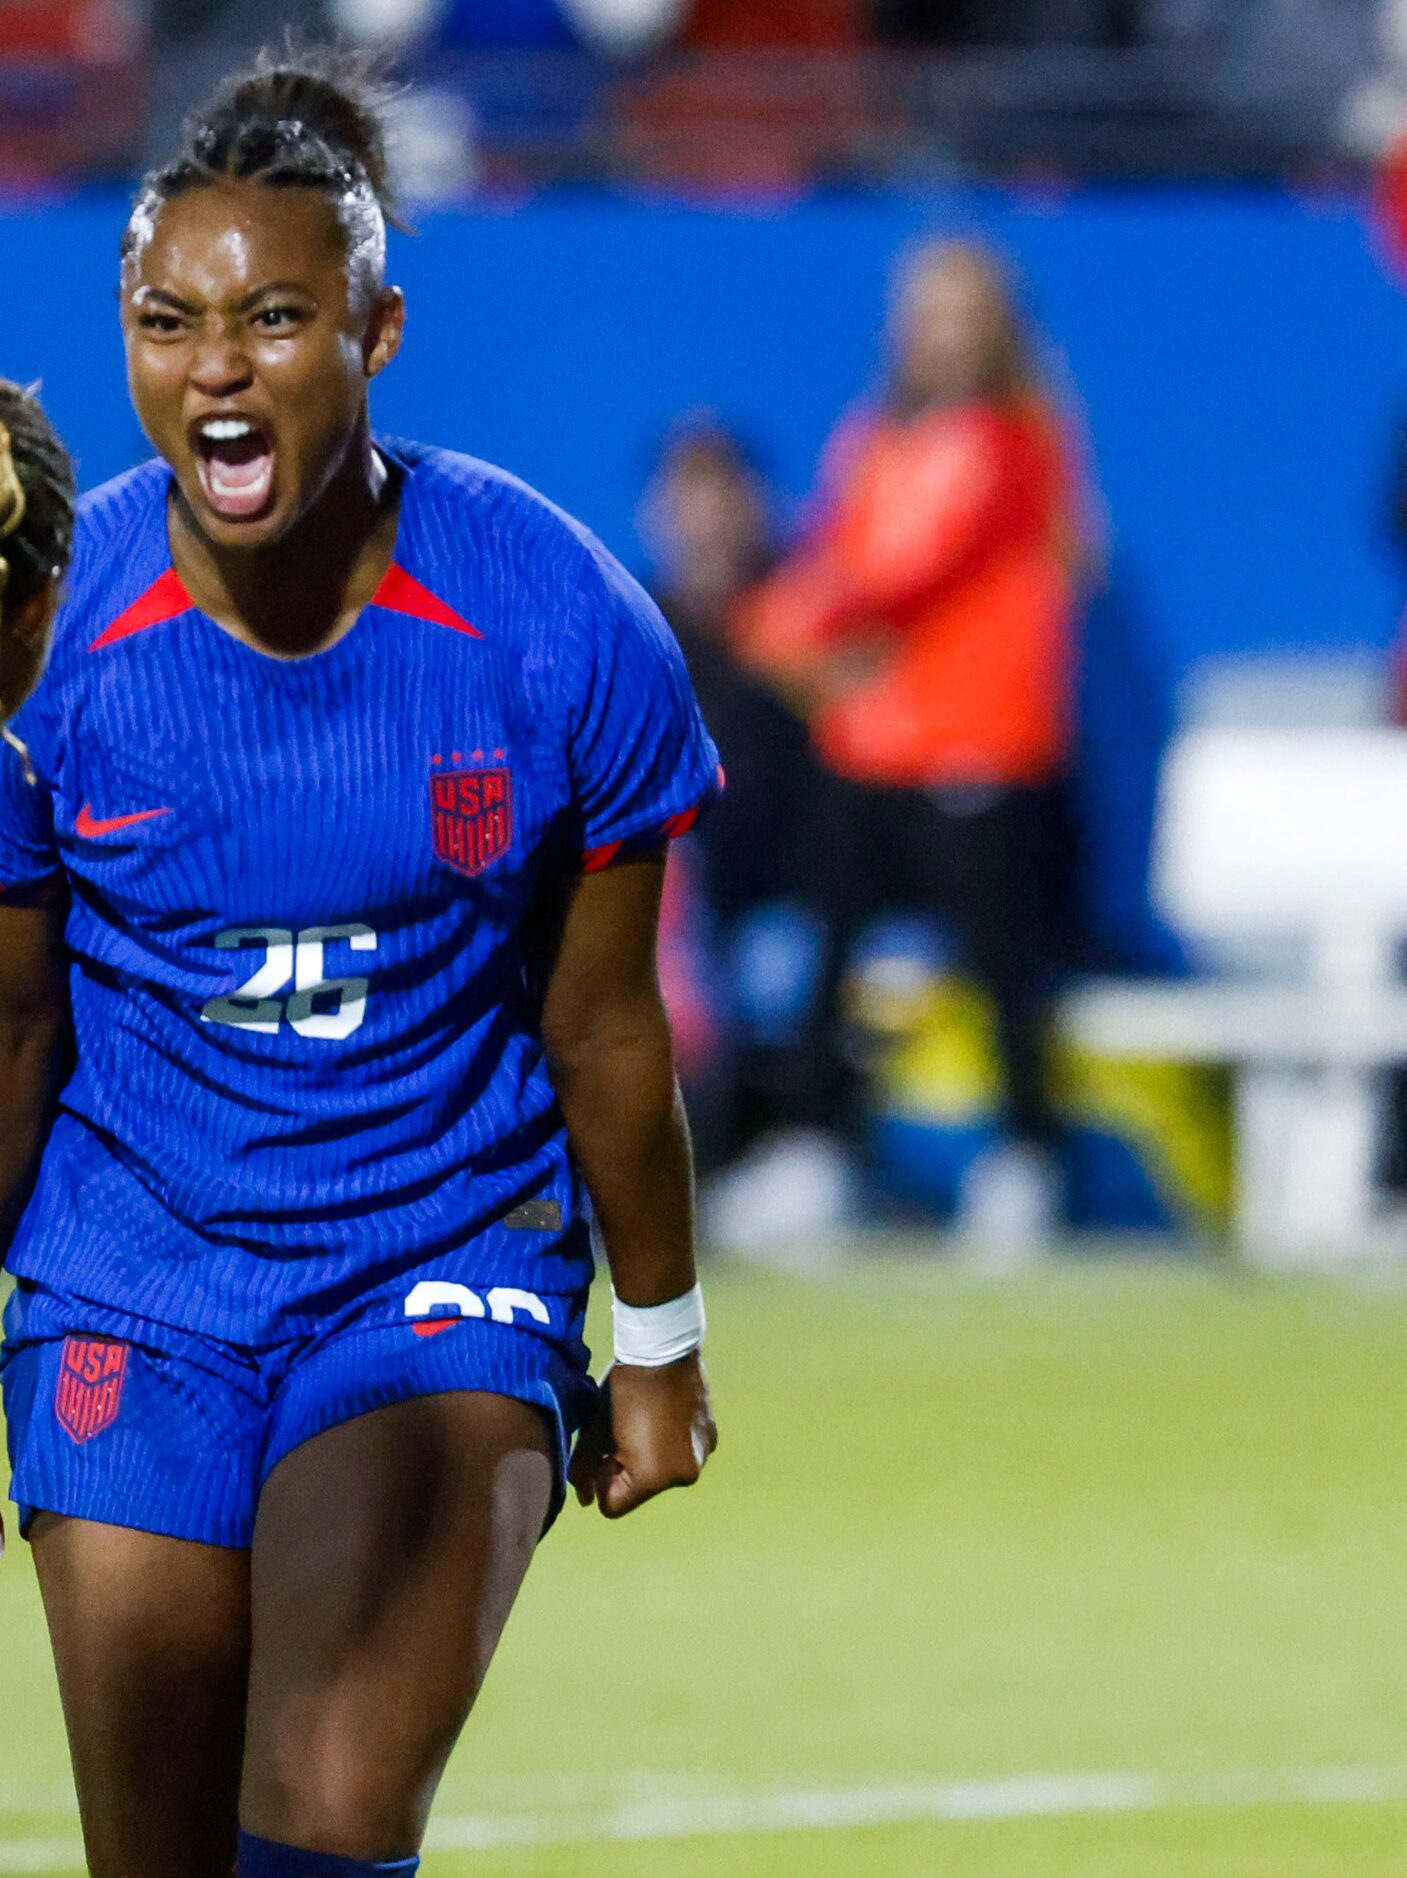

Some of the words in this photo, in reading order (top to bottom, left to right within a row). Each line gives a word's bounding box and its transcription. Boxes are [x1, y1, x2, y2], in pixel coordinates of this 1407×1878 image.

[436, 776, 504, 816] USA
[200, 923, 377, 1041] 26
[67, 1340, 124, 1383] USA
